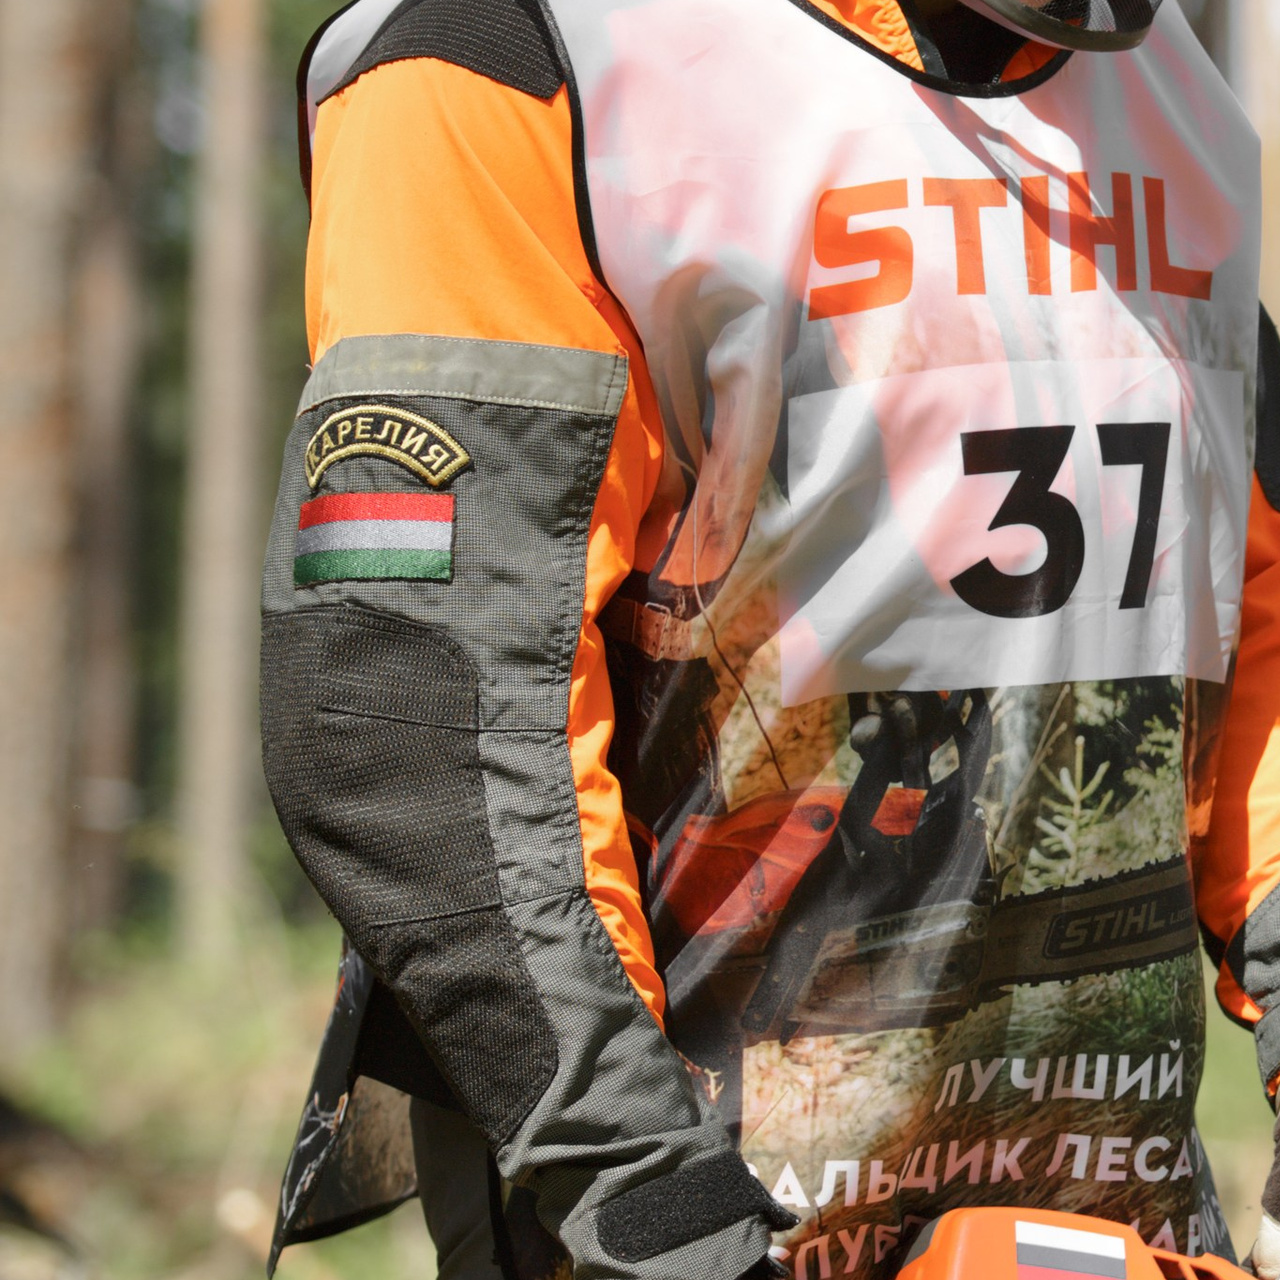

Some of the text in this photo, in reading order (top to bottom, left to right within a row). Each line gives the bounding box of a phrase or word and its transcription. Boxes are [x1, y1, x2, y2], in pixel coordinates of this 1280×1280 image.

[808, 171, 1213, 321] STIHL
[309, 417, 450, 471] КАРЕЛИЯ
[949, 422, 1171, 618] 37
[1060, 900, 1165, 950] STIHL
[935, 1039, 1183, 1113] ЛУЧШИЙ
[745, 1137, 1032, 1208] АЛЬЩИК
